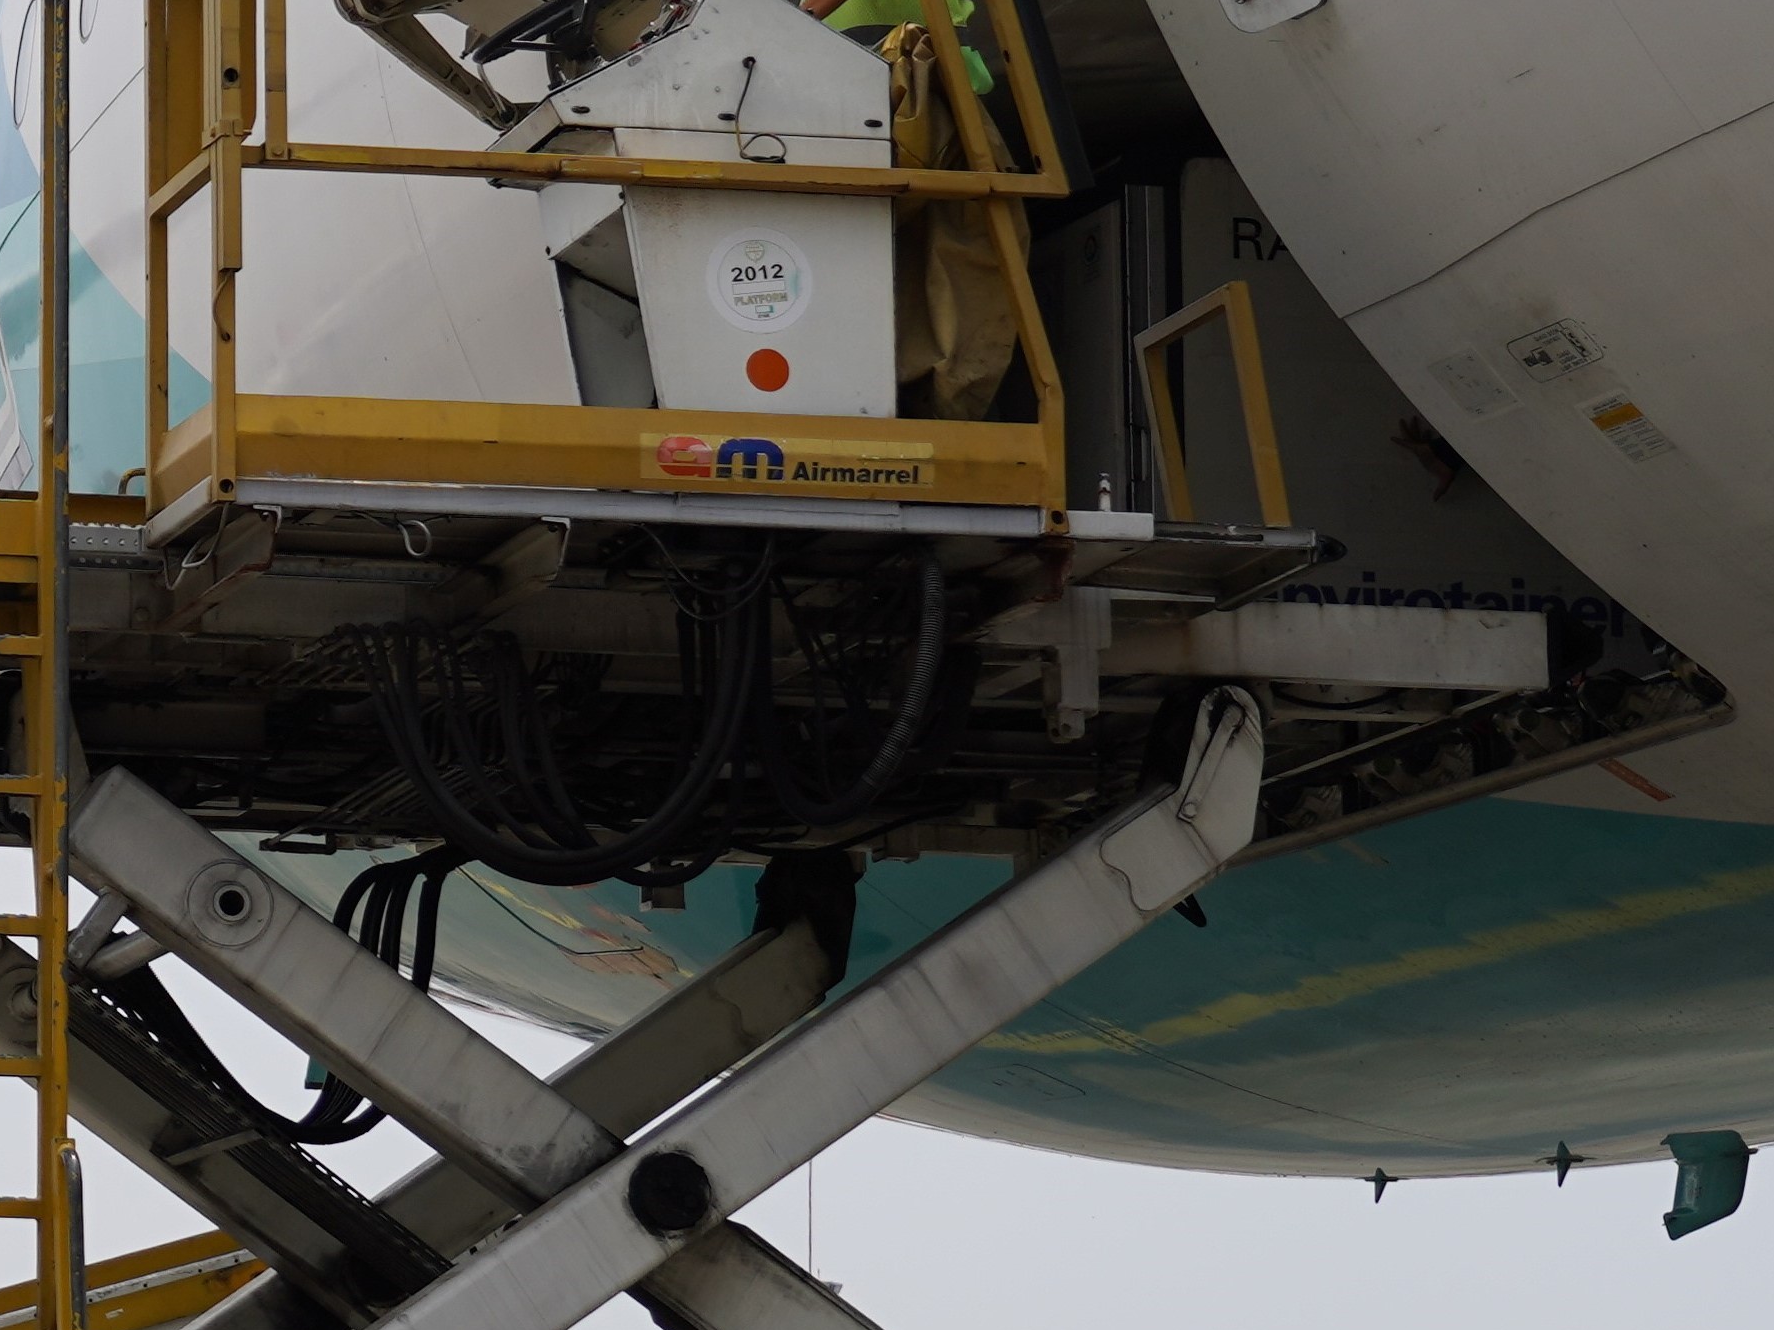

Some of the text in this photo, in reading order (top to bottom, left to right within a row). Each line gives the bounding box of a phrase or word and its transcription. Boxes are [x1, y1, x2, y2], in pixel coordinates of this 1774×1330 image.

[730, 264, 784, 282] 2012
[733, 292, 788, 306] PLATFORM
[792, 461, 919, 484] Airmarrel
